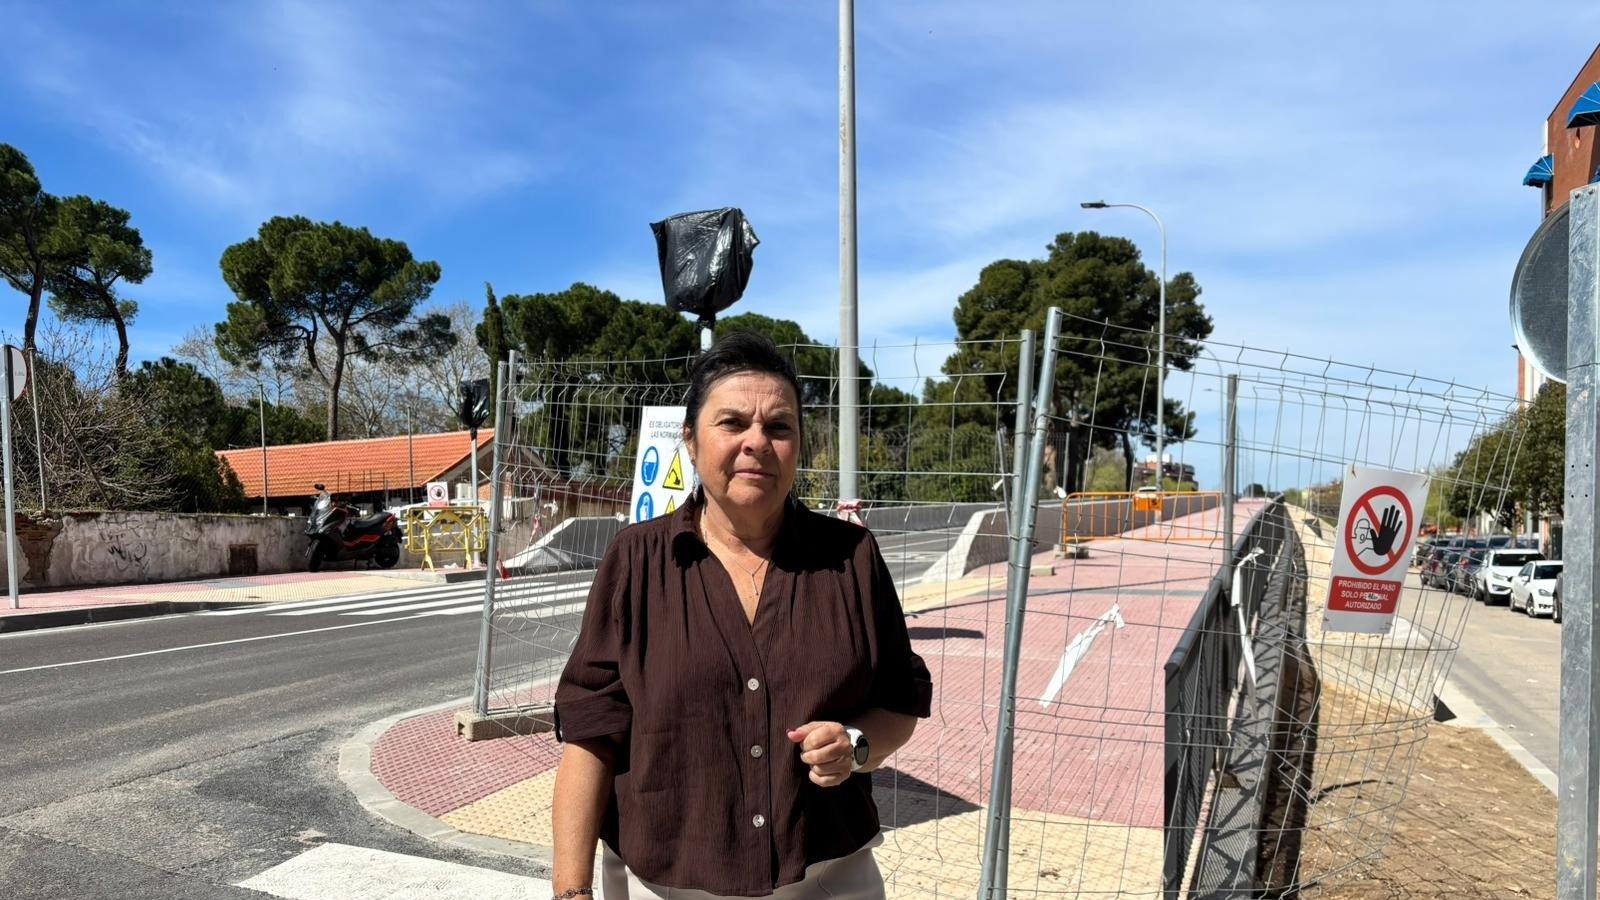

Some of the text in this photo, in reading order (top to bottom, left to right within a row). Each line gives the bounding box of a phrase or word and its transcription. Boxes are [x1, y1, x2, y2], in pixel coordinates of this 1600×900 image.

[1338, 580, 1372, 589] PROHIBIDO
[1372, 583, 1380, 591] EL
[1341, 590, 1358, 598] SOLO
[1345, 601, 1382, 610] AUTORIZADO
